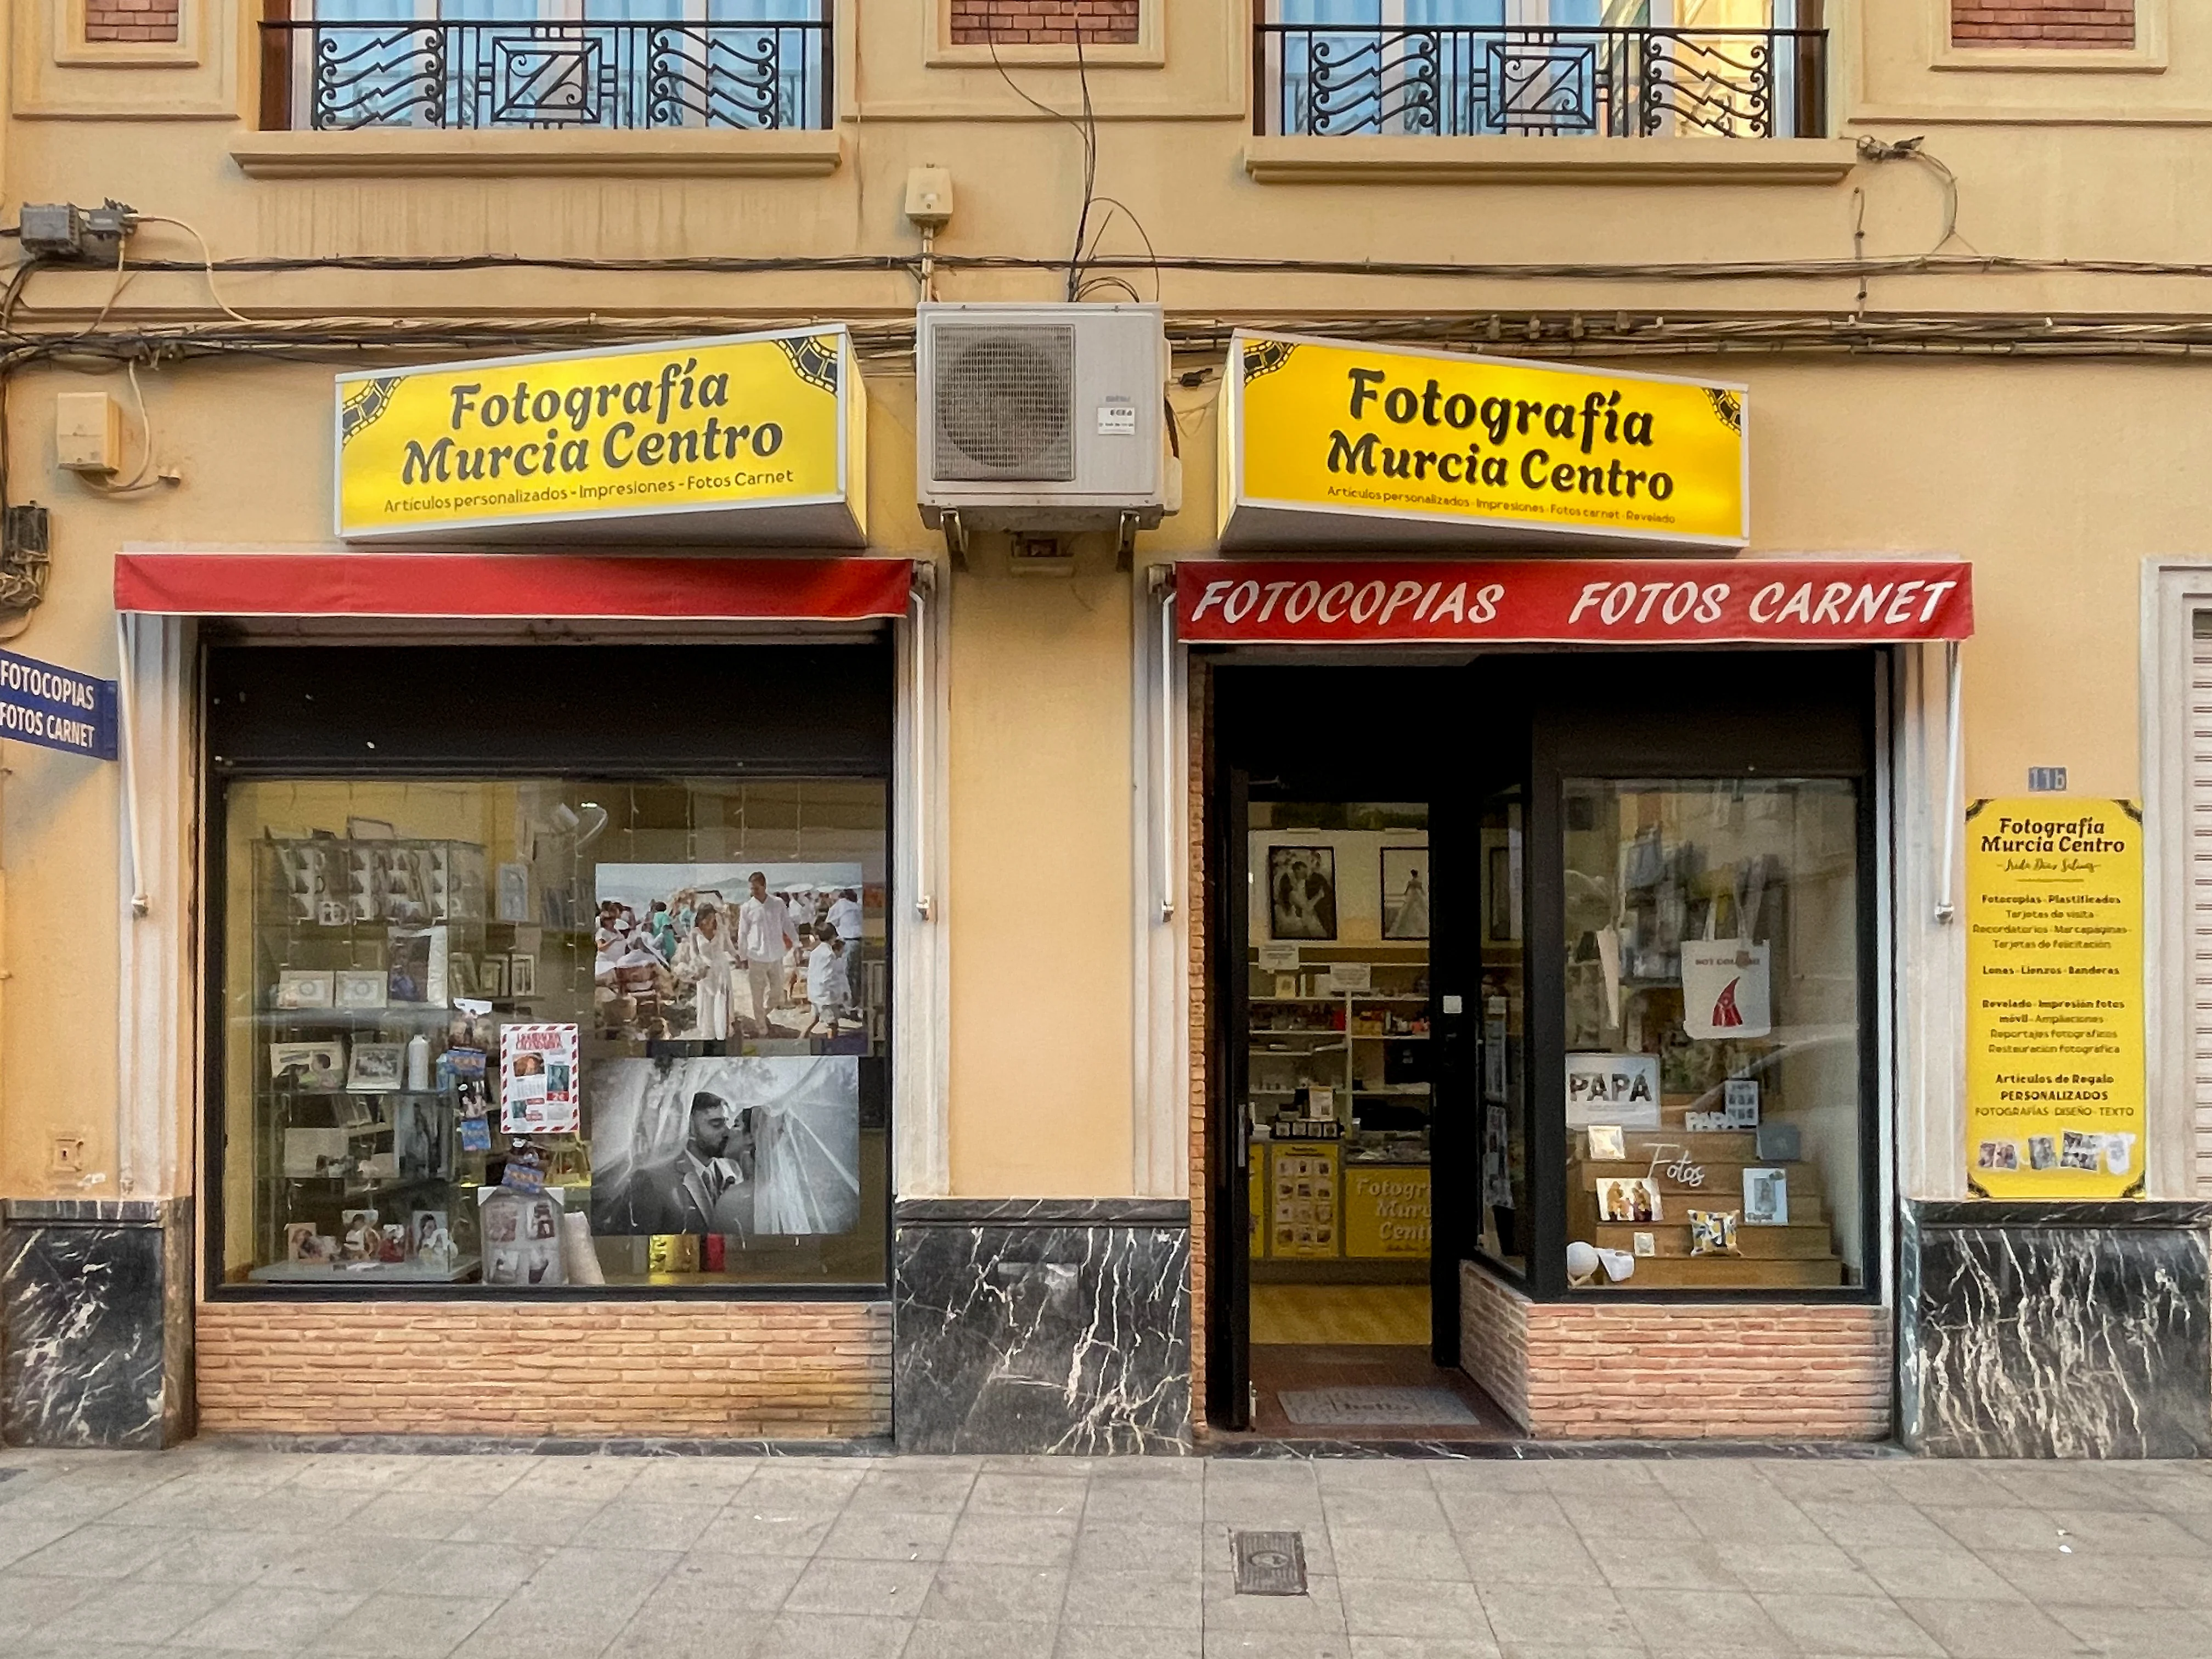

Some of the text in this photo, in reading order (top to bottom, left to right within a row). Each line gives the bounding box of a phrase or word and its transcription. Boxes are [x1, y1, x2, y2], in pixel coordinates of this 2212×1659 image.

[451, 358, 728, 430] Fotografía
[1347, 368, 1654, 453] Fotografía
[402, 417, 782, 484] Murcia Centro
[1327, 430, 1673, 502] Murcia Centro
[384, 469, 793, 512] Artículos personalizados Impresiones Fotos Carnet
[1383, 491, 1469, 508] personalizados
[1476, 500, 1545, 516] Impresiones
[1550, 504, 1581, 516] Fotos
[1583, 508, 1620, 520] carnet
[1626, 511, 1675, 524] Revelado
[1192, 579, 1957, 625] FOTOCOPIAS FOTOS CARNET
[1, 659, 94, 710] FOTOCOPIAS
[0, 702, 95, 748] FOTOS CARNET
[1999, 816, 2105, 838] Fotografía
[1981, 835, 2125, 853] Murcia Centro
[1982, 894, 2121, 905] Fotocopias Plastificados
[2006, 910, 2049, 920] Tarjetas
[2051, 910, 2064, 918] de
[1973, 924, 2048, 935] Recordatorios
[1993, 940, 2036, 950] Tarjetas
[2038, 940, 2051, 949] de
[1983, 966, 2014, 975] Lonas
[2069, 966, 2120, 975] Banderas
[1983, 1000, 2032, 1009] Revelado
[2096, 1000, 2125, 1009] fotos
[1990, 1029, 2049, 1040] Reportajes
[1570, 1069, 1652, 1102] PAPÁ
[2055, 1074, 2069, 1084] de
[2072, 1074, 2114, 1086] Regalo
[2001, 1091, 2108, 1101] PERSONALIZADOS
[2055, 1105, 2092, 1116] DISEÑO
[2100, 1107, 2134, 1116] TEXTO
[1643, 1143, 1705, 1187] Fotos
[1356, 1178, 1431, 1200] Fotogr
